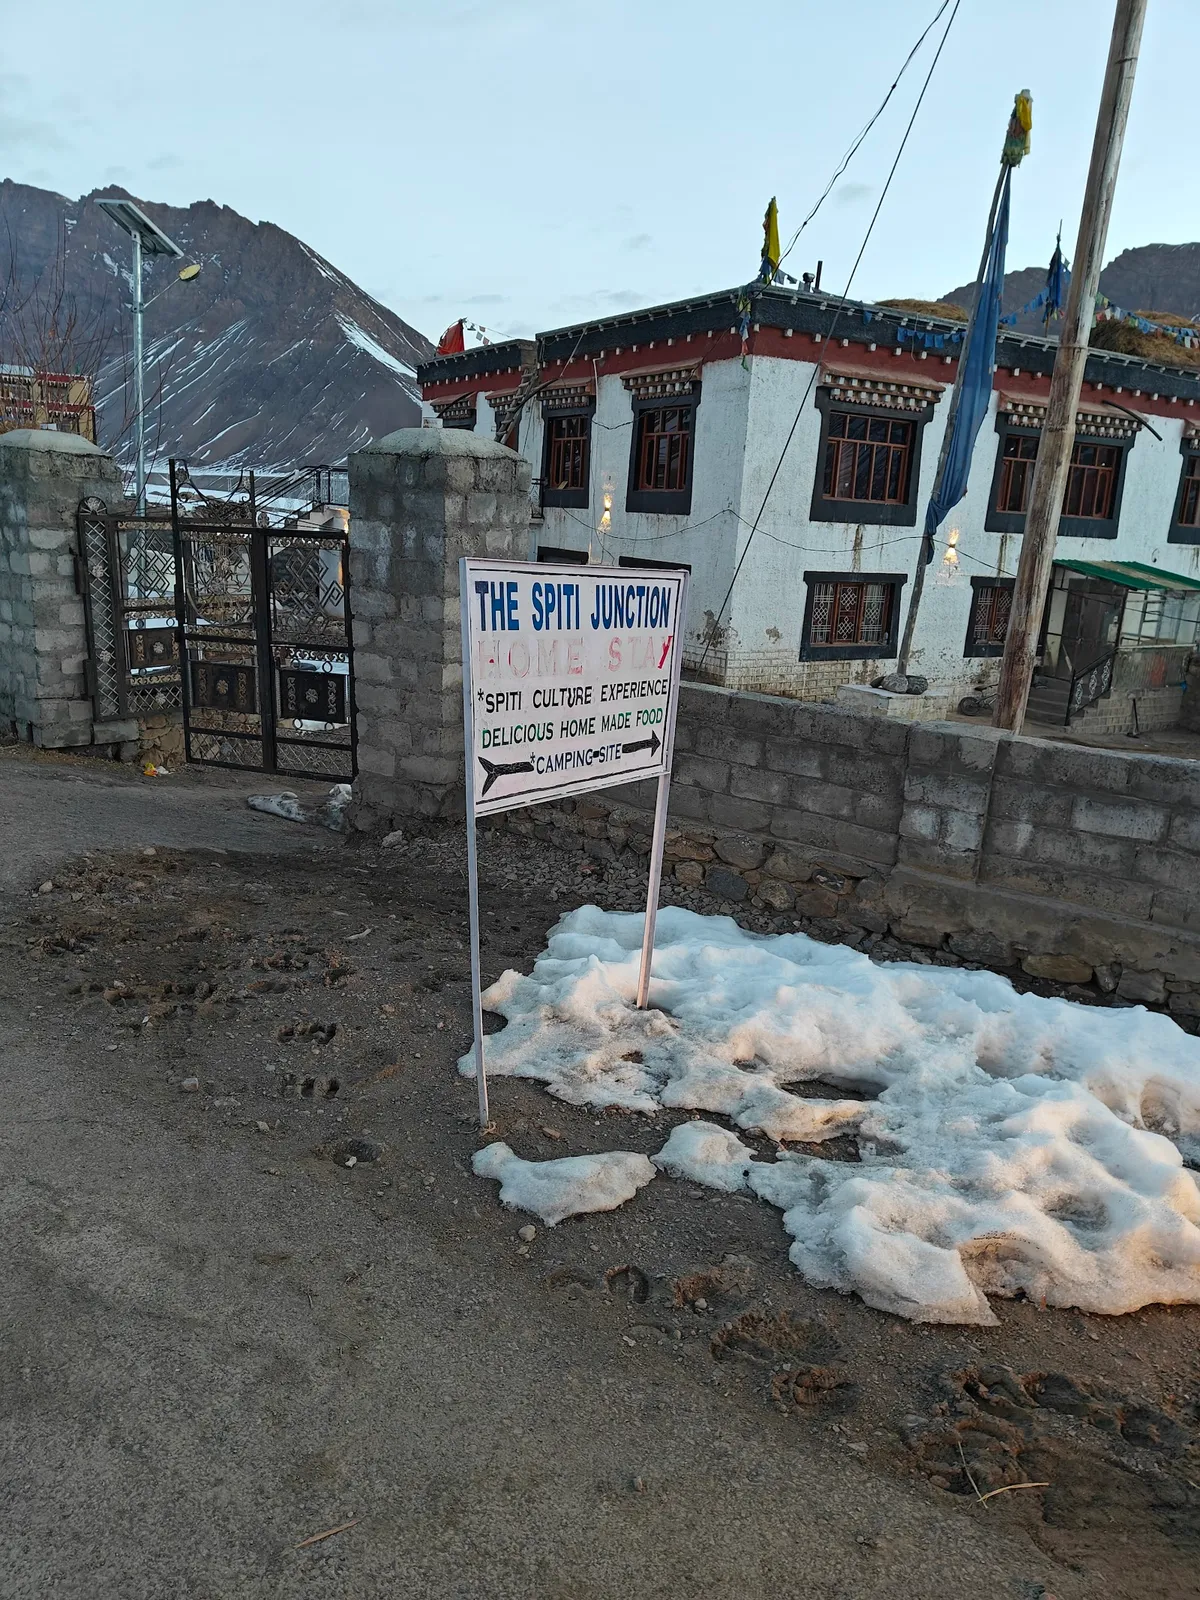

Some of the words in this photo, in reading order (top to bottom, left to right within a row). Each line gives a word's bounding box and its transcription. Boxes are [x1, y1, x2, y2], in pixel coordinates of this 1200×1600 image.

[475, 580, 519, 631] THE
[532, 582, 580, 631] SPITI
[591, 584, 672, 630] JUNCTION
[532, 686, 592, 708] CULTURE
[600, 679, 668, 702] EXPERIENCE
[482, 722, 554, 749] DELICIOUS
[560, 717, 596, 739] HOME
[601, 712, 632, 733] MADE
[636, 708, 663, 727] FOOD
